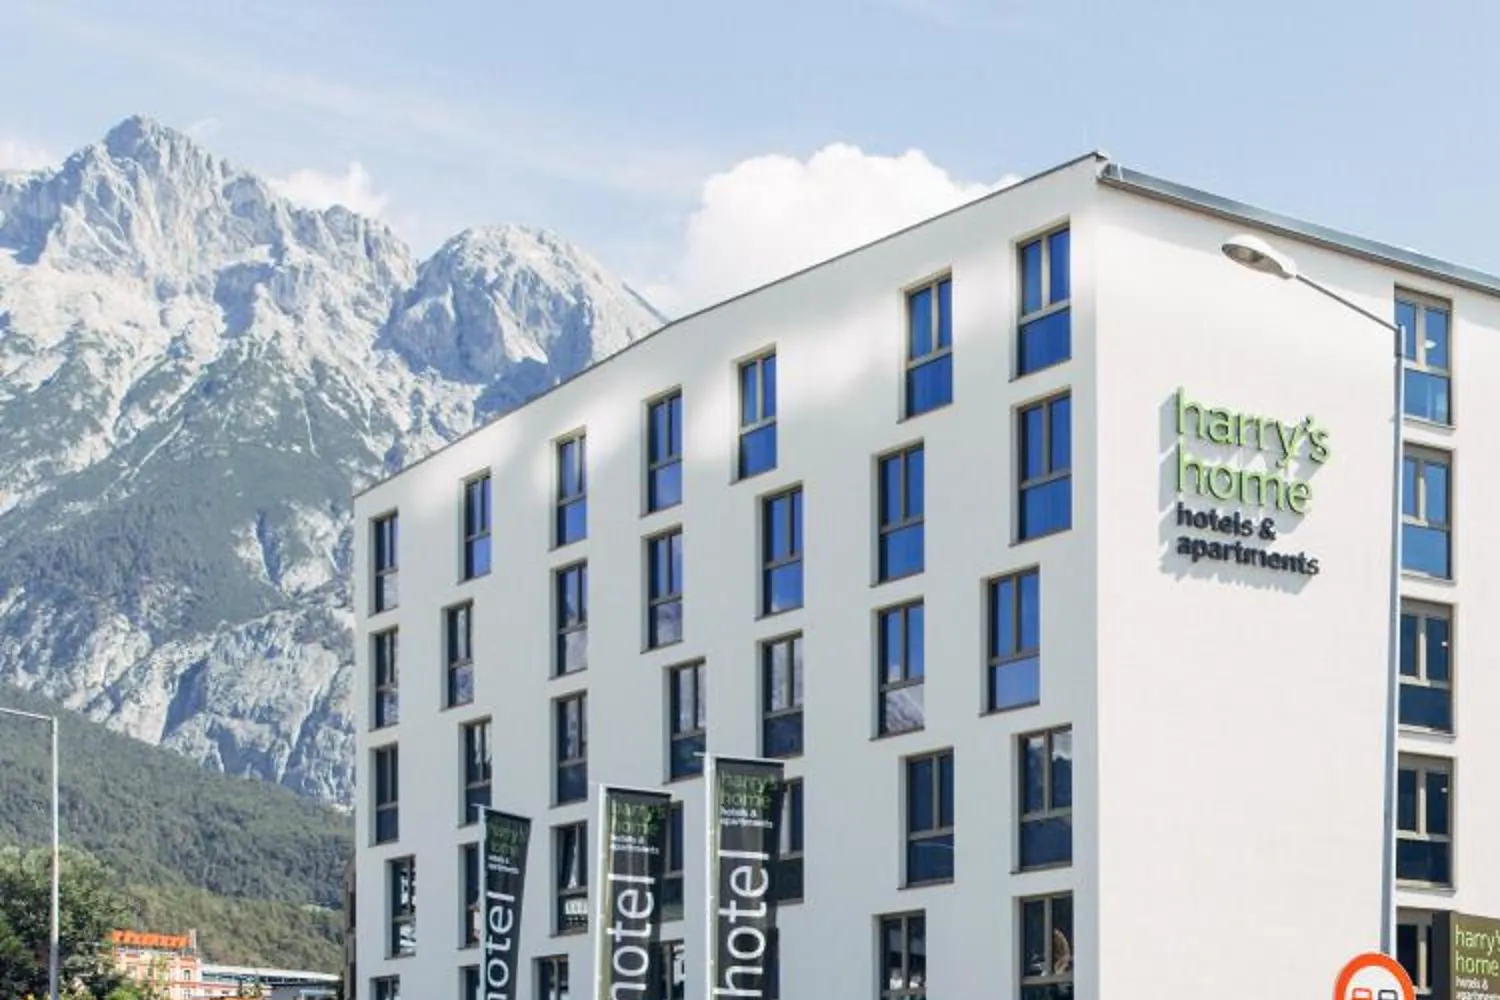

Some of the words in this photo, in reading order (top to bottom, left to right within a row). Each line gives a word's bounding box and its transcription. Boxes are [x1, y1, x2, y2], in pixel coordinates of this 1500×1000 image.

[1175, 385, 1330, 469] harry's
[1175, 441, 1313, 515] home
[1176, 501, 1254, 537] hotels
[1258, 516, 1276, 541] &
[1176, 534, 1320, 576] apartments
[712, 849, 770, 998] hotel
[1455, 949, 1500, 977] home
